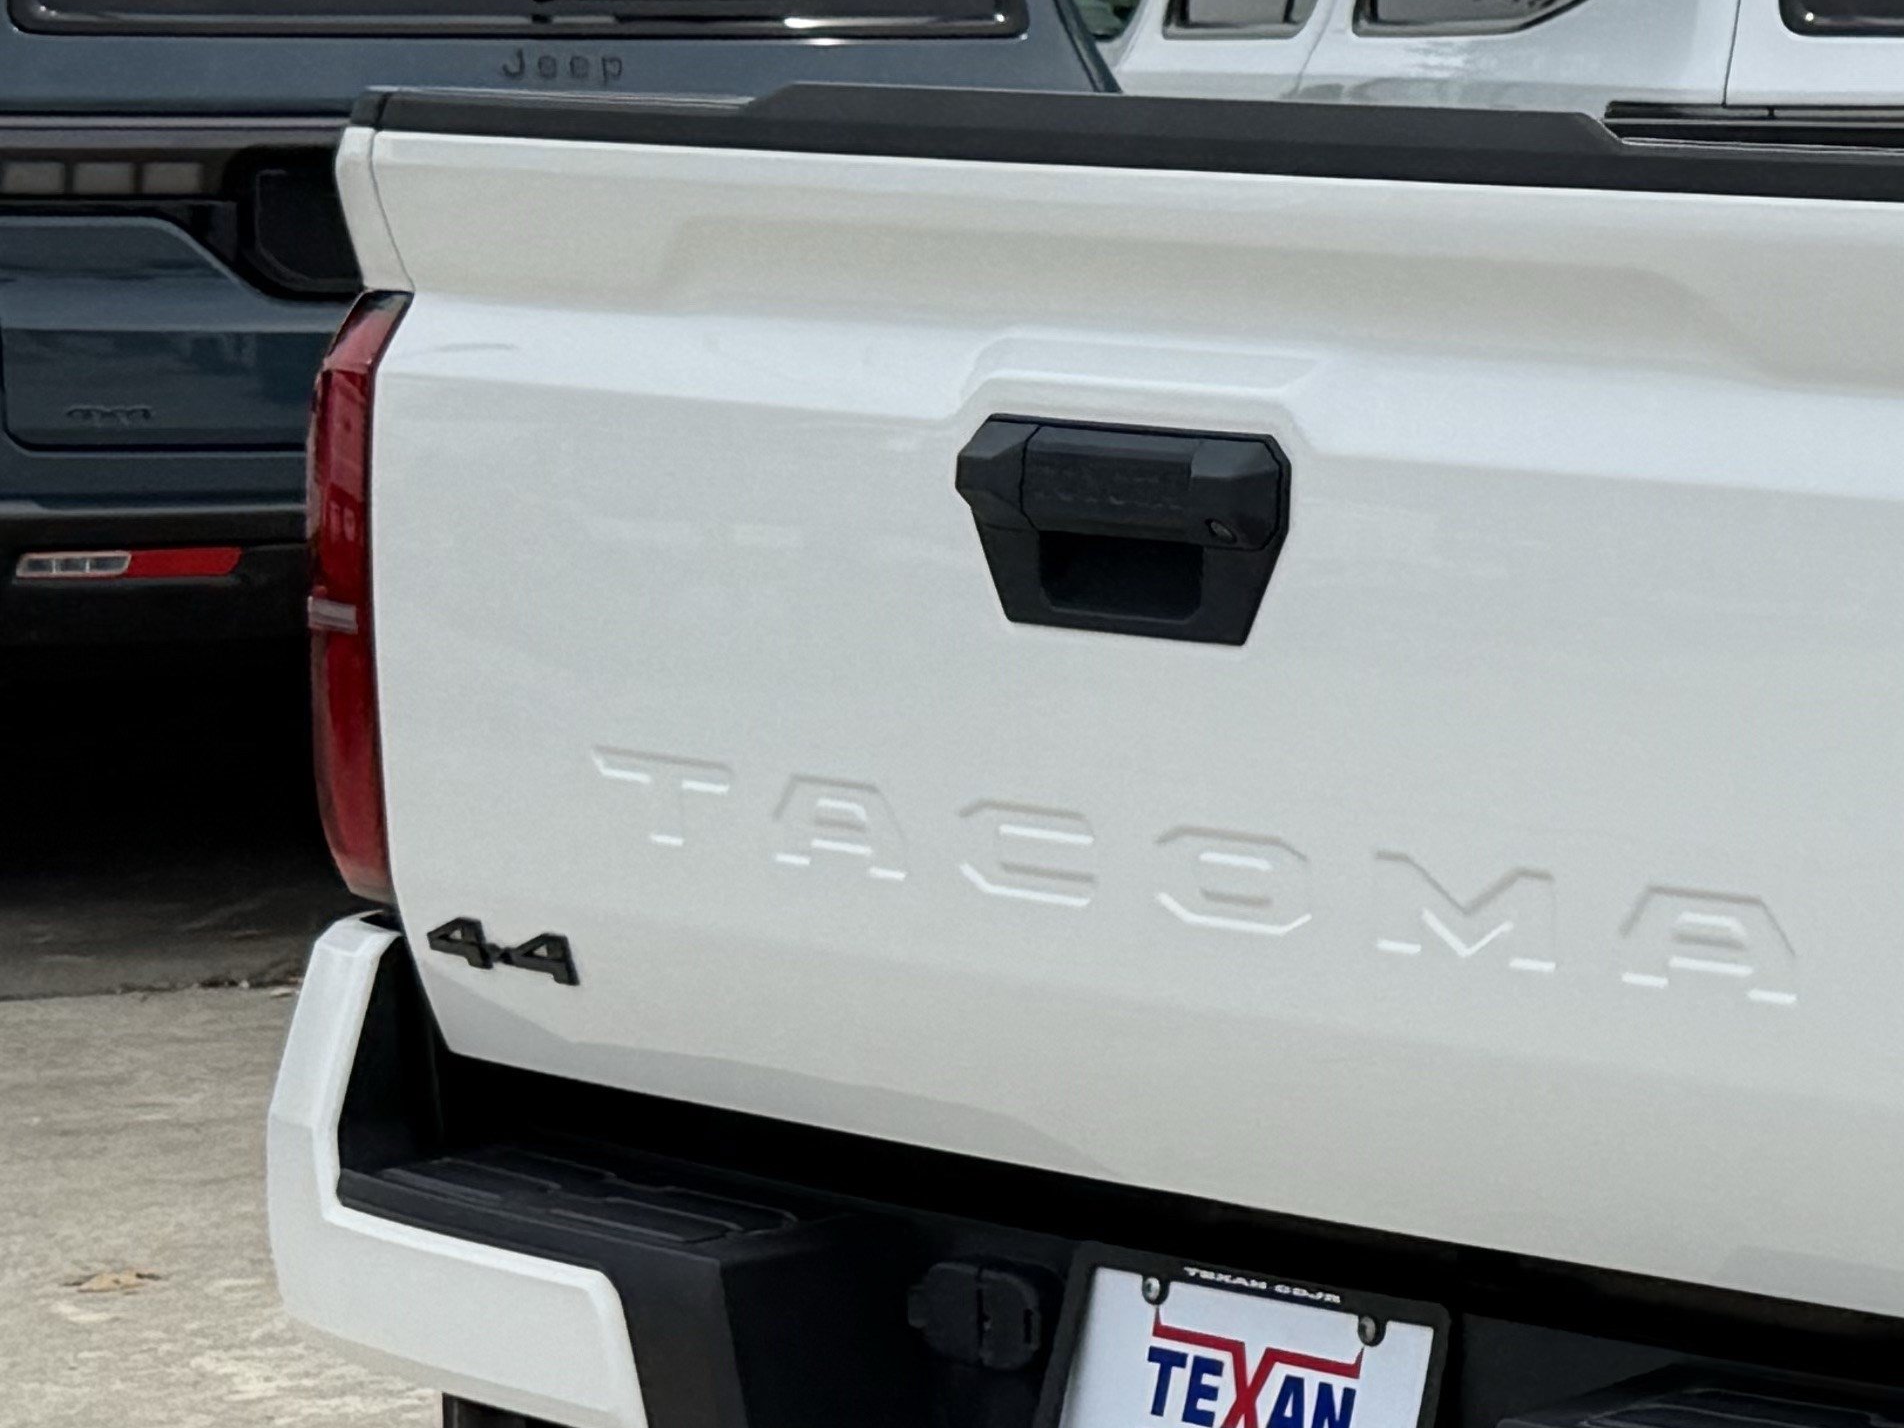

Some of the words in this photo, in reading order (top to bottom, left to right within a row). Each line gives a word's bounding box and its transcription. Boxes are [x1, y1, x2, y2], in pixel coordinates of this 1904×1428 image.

[502, 47, 623, 86] Jeep
[593, 744, 1797, 1005] TACOMA
[1183, 1265, 1268, 1291] TEXAN
